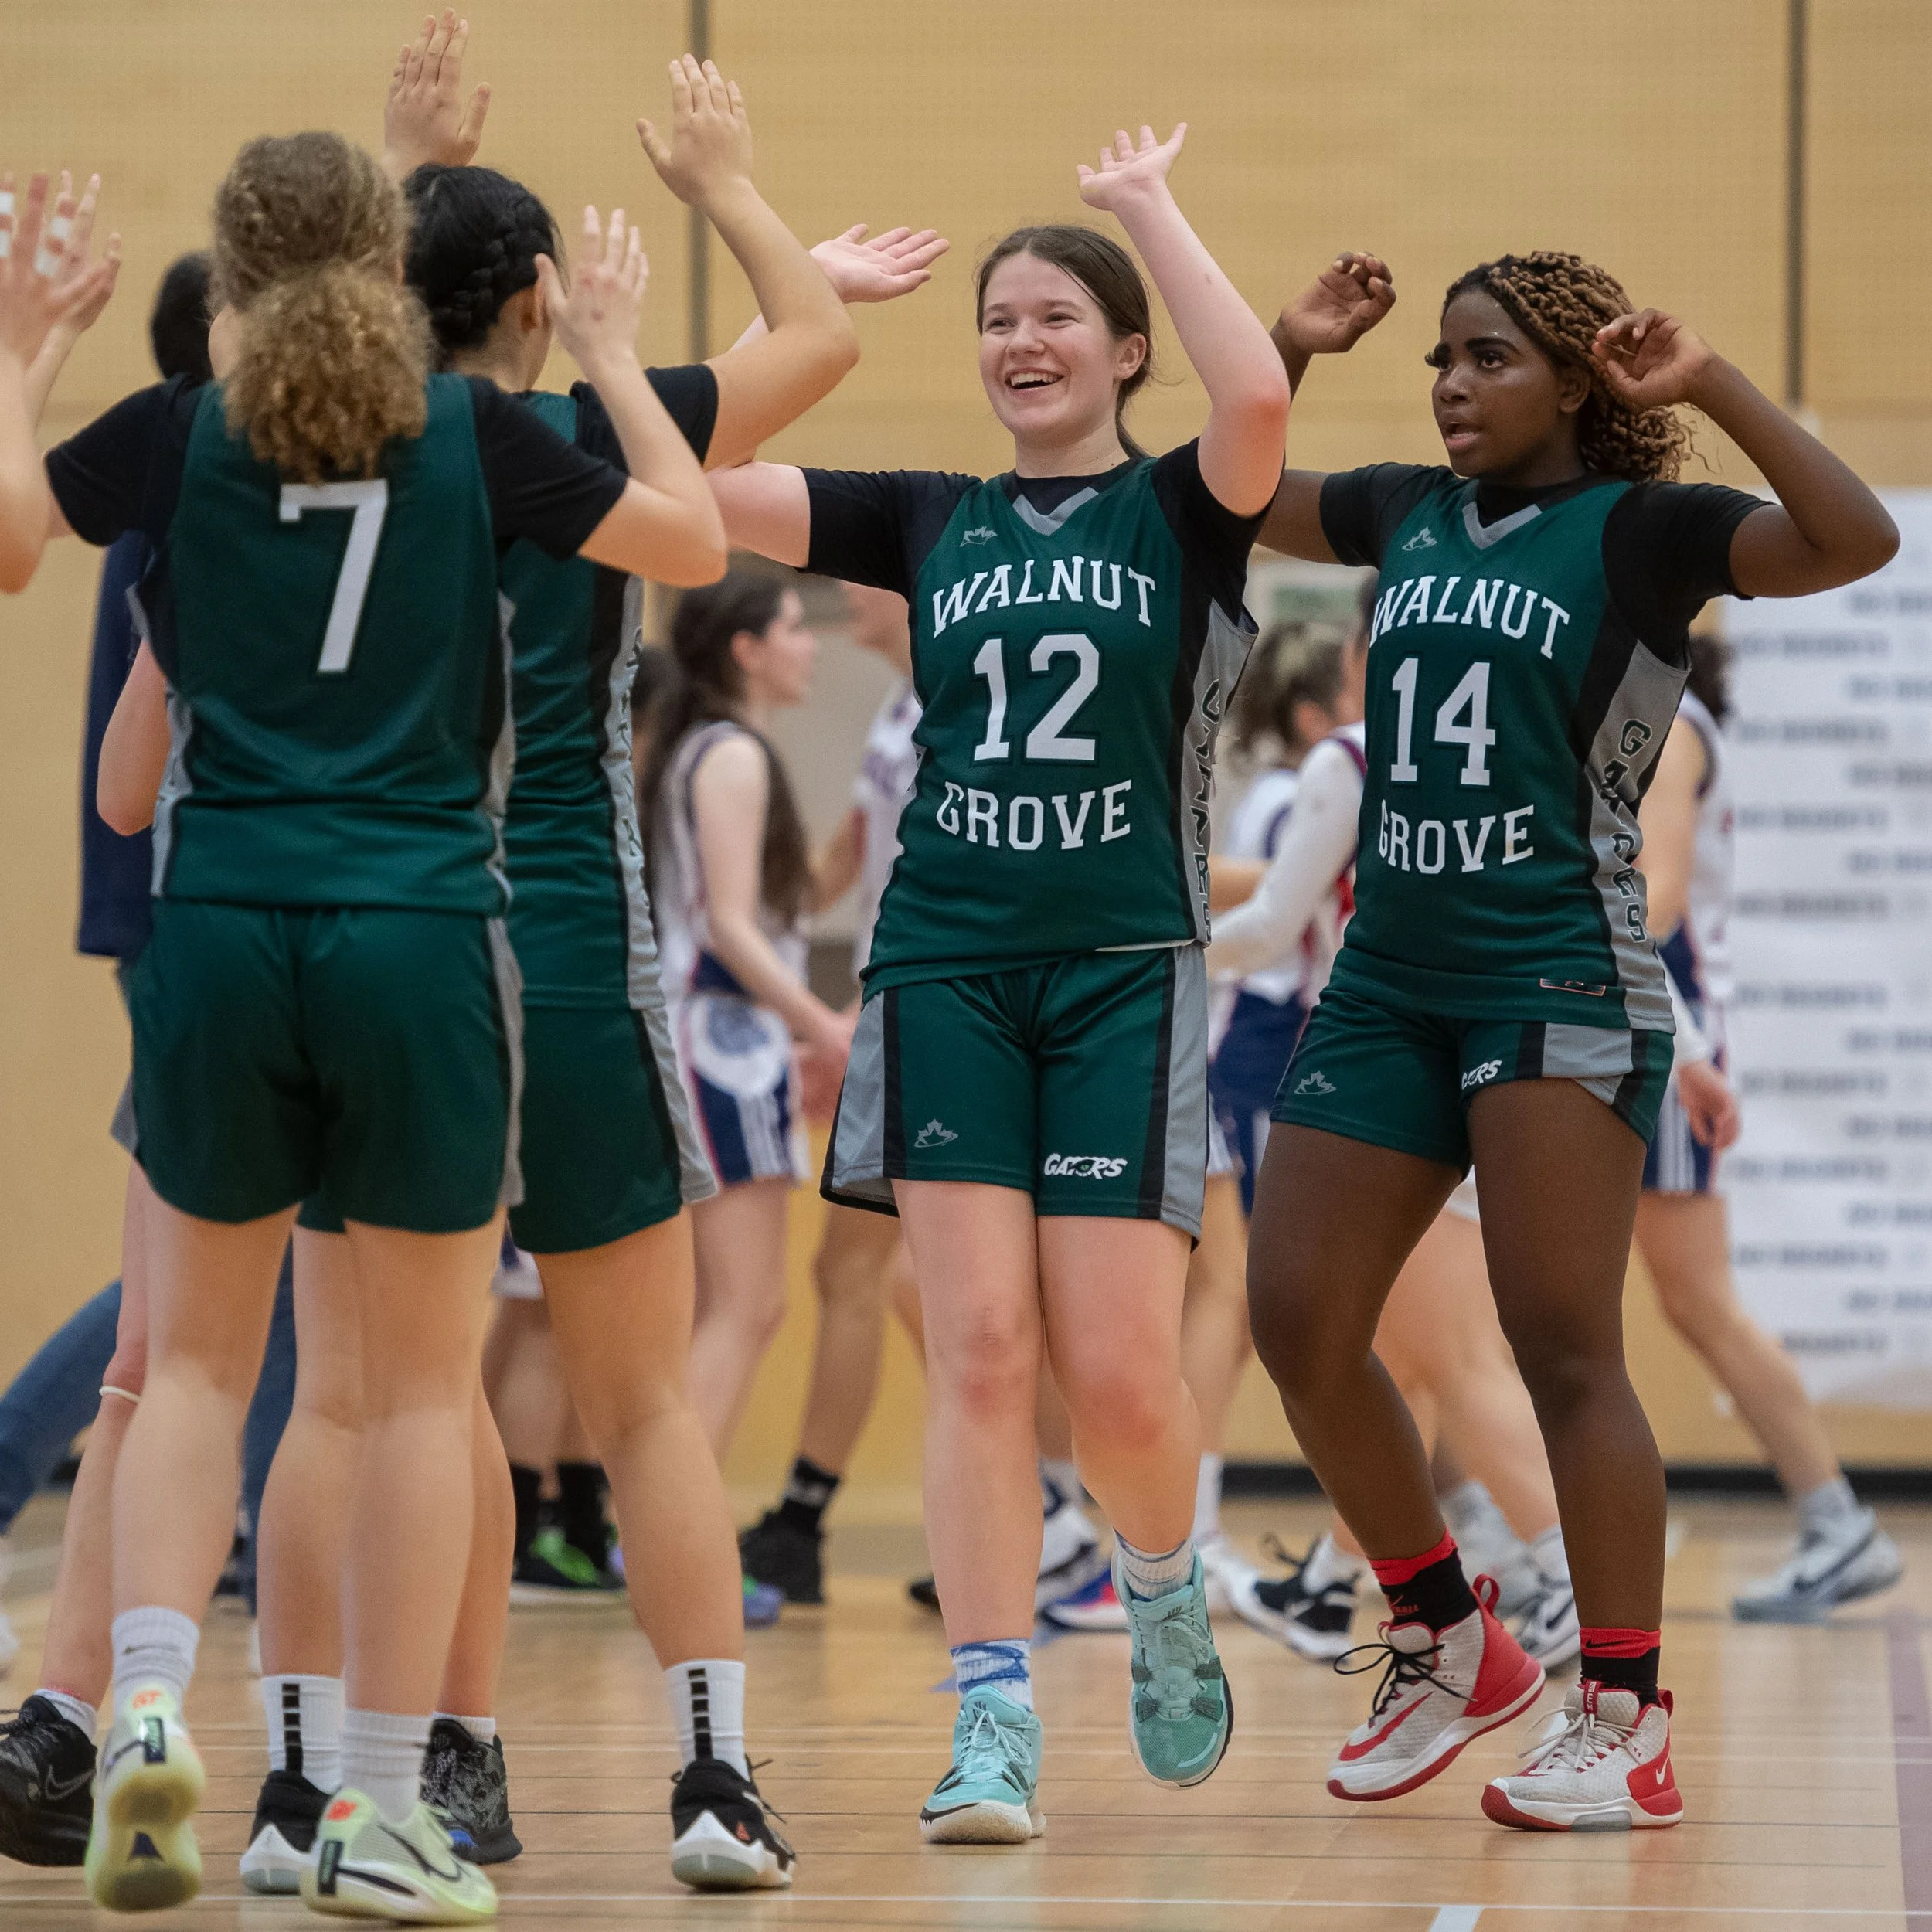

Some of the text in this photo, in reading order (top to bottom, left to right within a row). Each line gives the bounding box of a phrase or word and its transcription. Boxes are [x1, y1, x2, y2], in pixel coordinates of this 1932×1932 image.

[280, 478, 388, 672] 7
[932, 555, 1156, 639] WALNUT
[1369, 575, 1570, 660] WALNUT
[973, 634, 1100, 761] 12
[1390, 658, 1496, 787] 14
[936, 779, 1131, 851] GROVE
[1379, 798, 1534, 874] GROVE
[1044, 1153, 1128, 1179] GATORS
